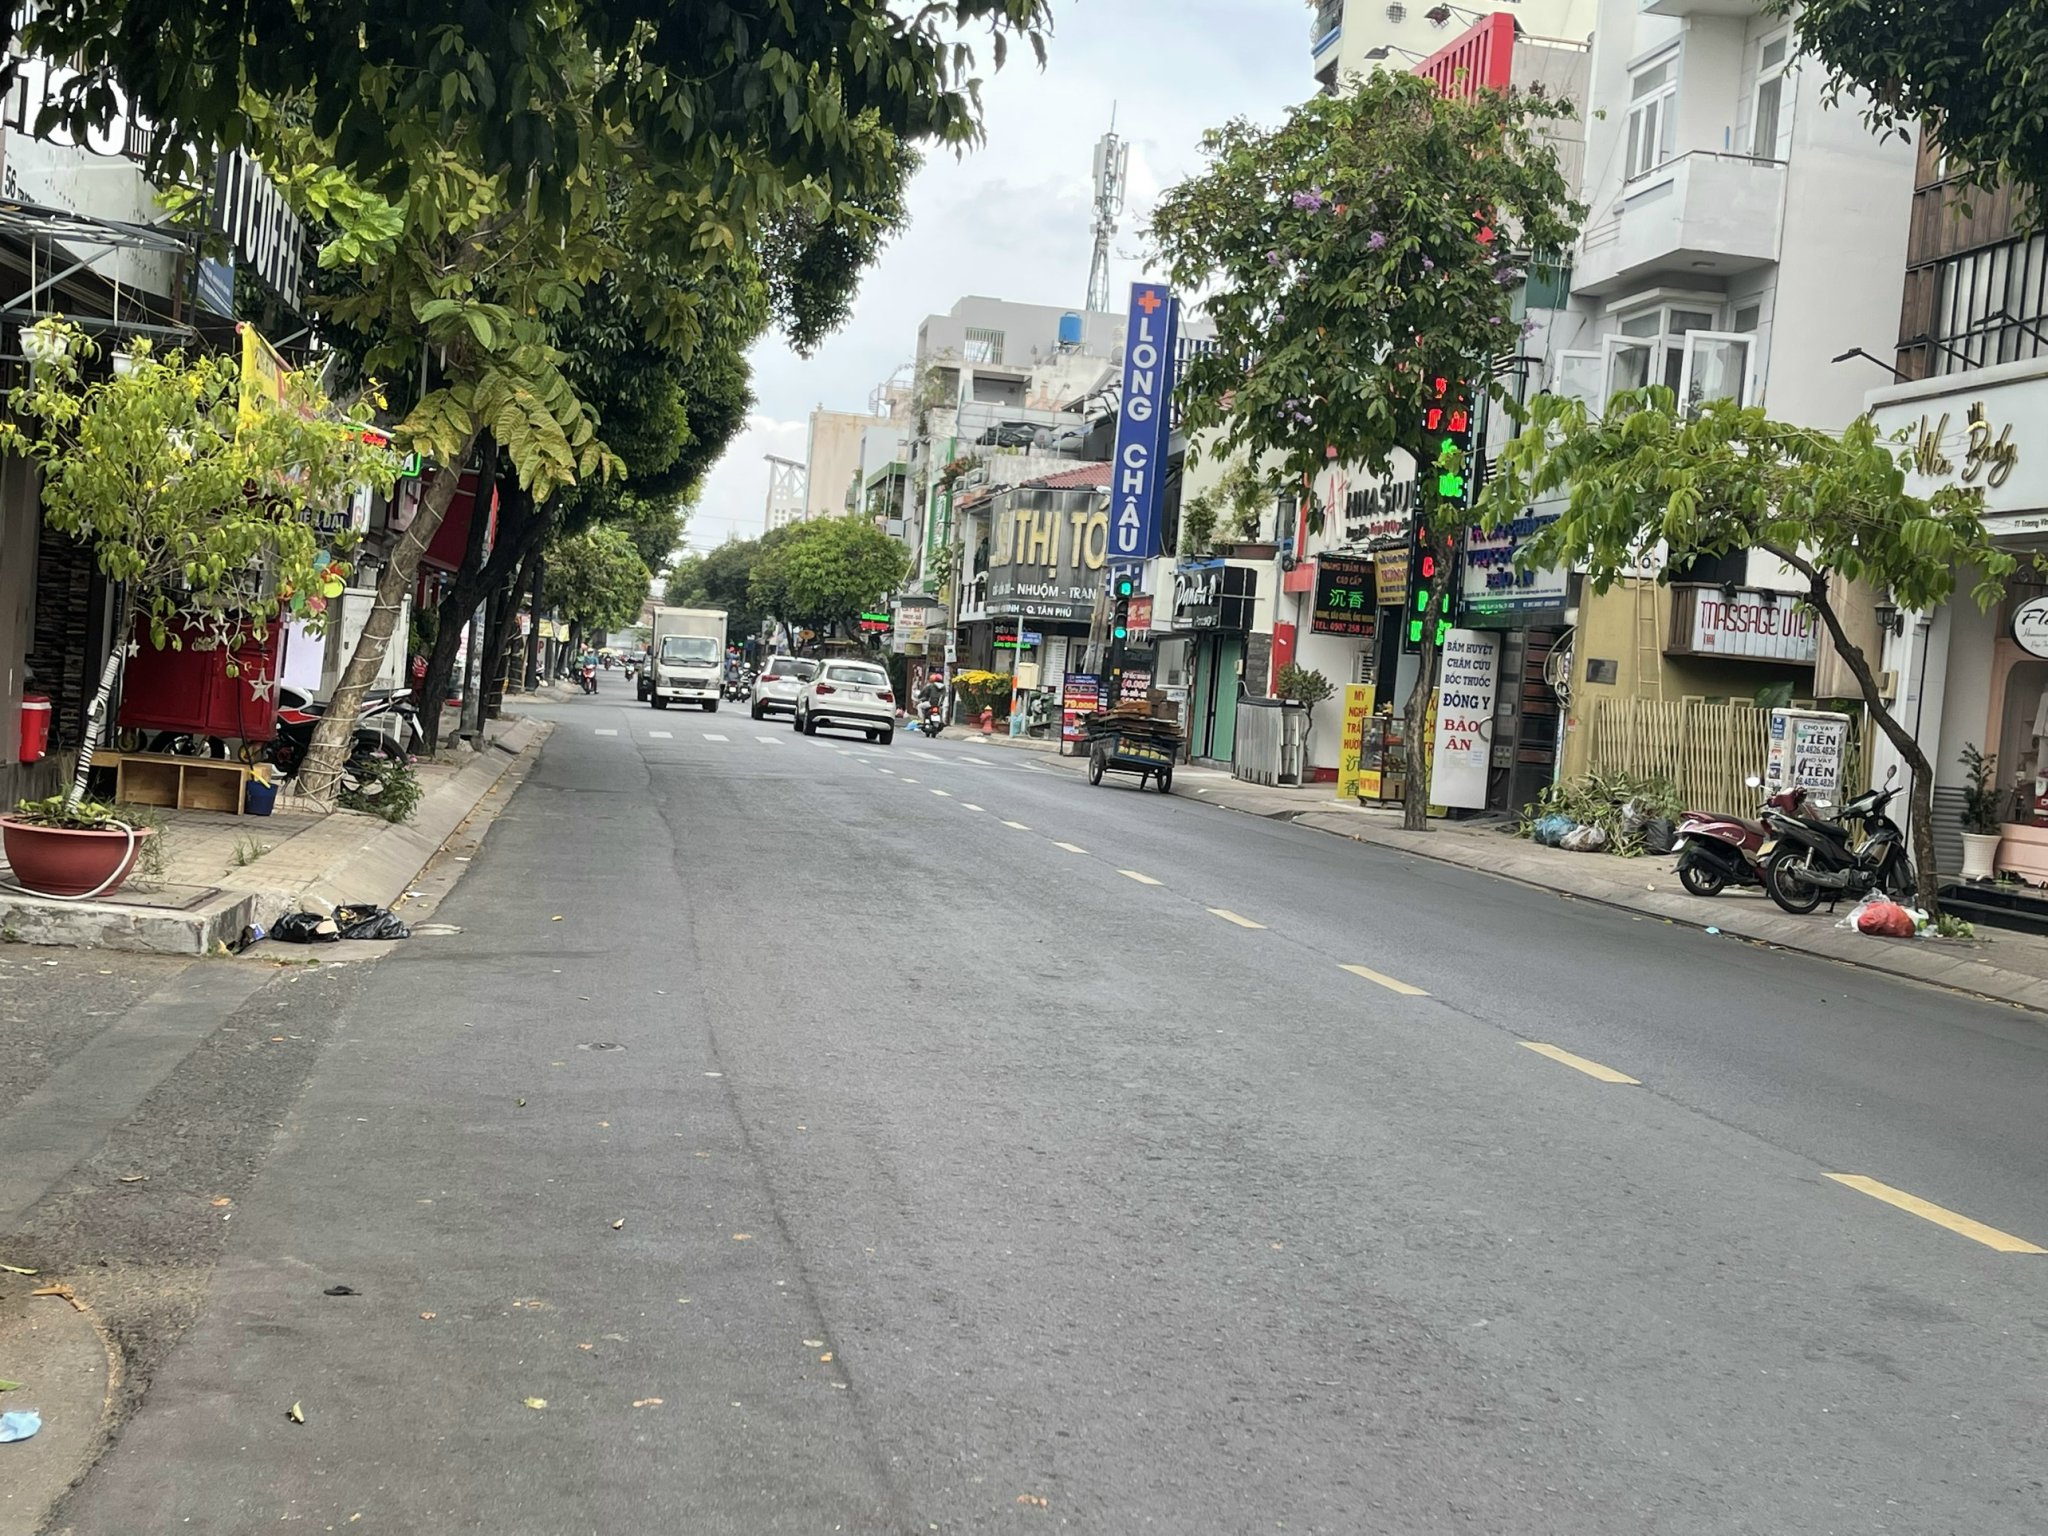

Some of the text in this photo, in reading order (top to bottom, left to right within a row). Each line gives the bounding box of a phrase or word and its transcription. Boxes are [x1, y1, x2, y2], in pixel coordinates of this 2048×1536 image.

[5, 164, 16, 199] 56
[1127, 317, 1157, 422] LONG
[1118, 443, 1148, 553] CHÂU
[1015, 510, 1060, 578] THỊ
[1017, 583, 1059, 599] NHUỘM
[1329, 588, 1364, 609] 沉香
[1037, 604, 1054, 616] TÂN
[1055, 606, 1072, 618] PHÚ
[1701, 600, 1780, 635] MASSAGE
[1466, 643, 1493, 655] HUYỆT
[1447, 657, 1491, 671] CHÂM CỨU
[1445, 671, 1490, 687] BỐC THUỐC
[1443, 690, 1491, 710] ĐÔNG Y
[1444, 716, 1478, 732] BẢO
[1445, 735, 1472, 751] ÂN
